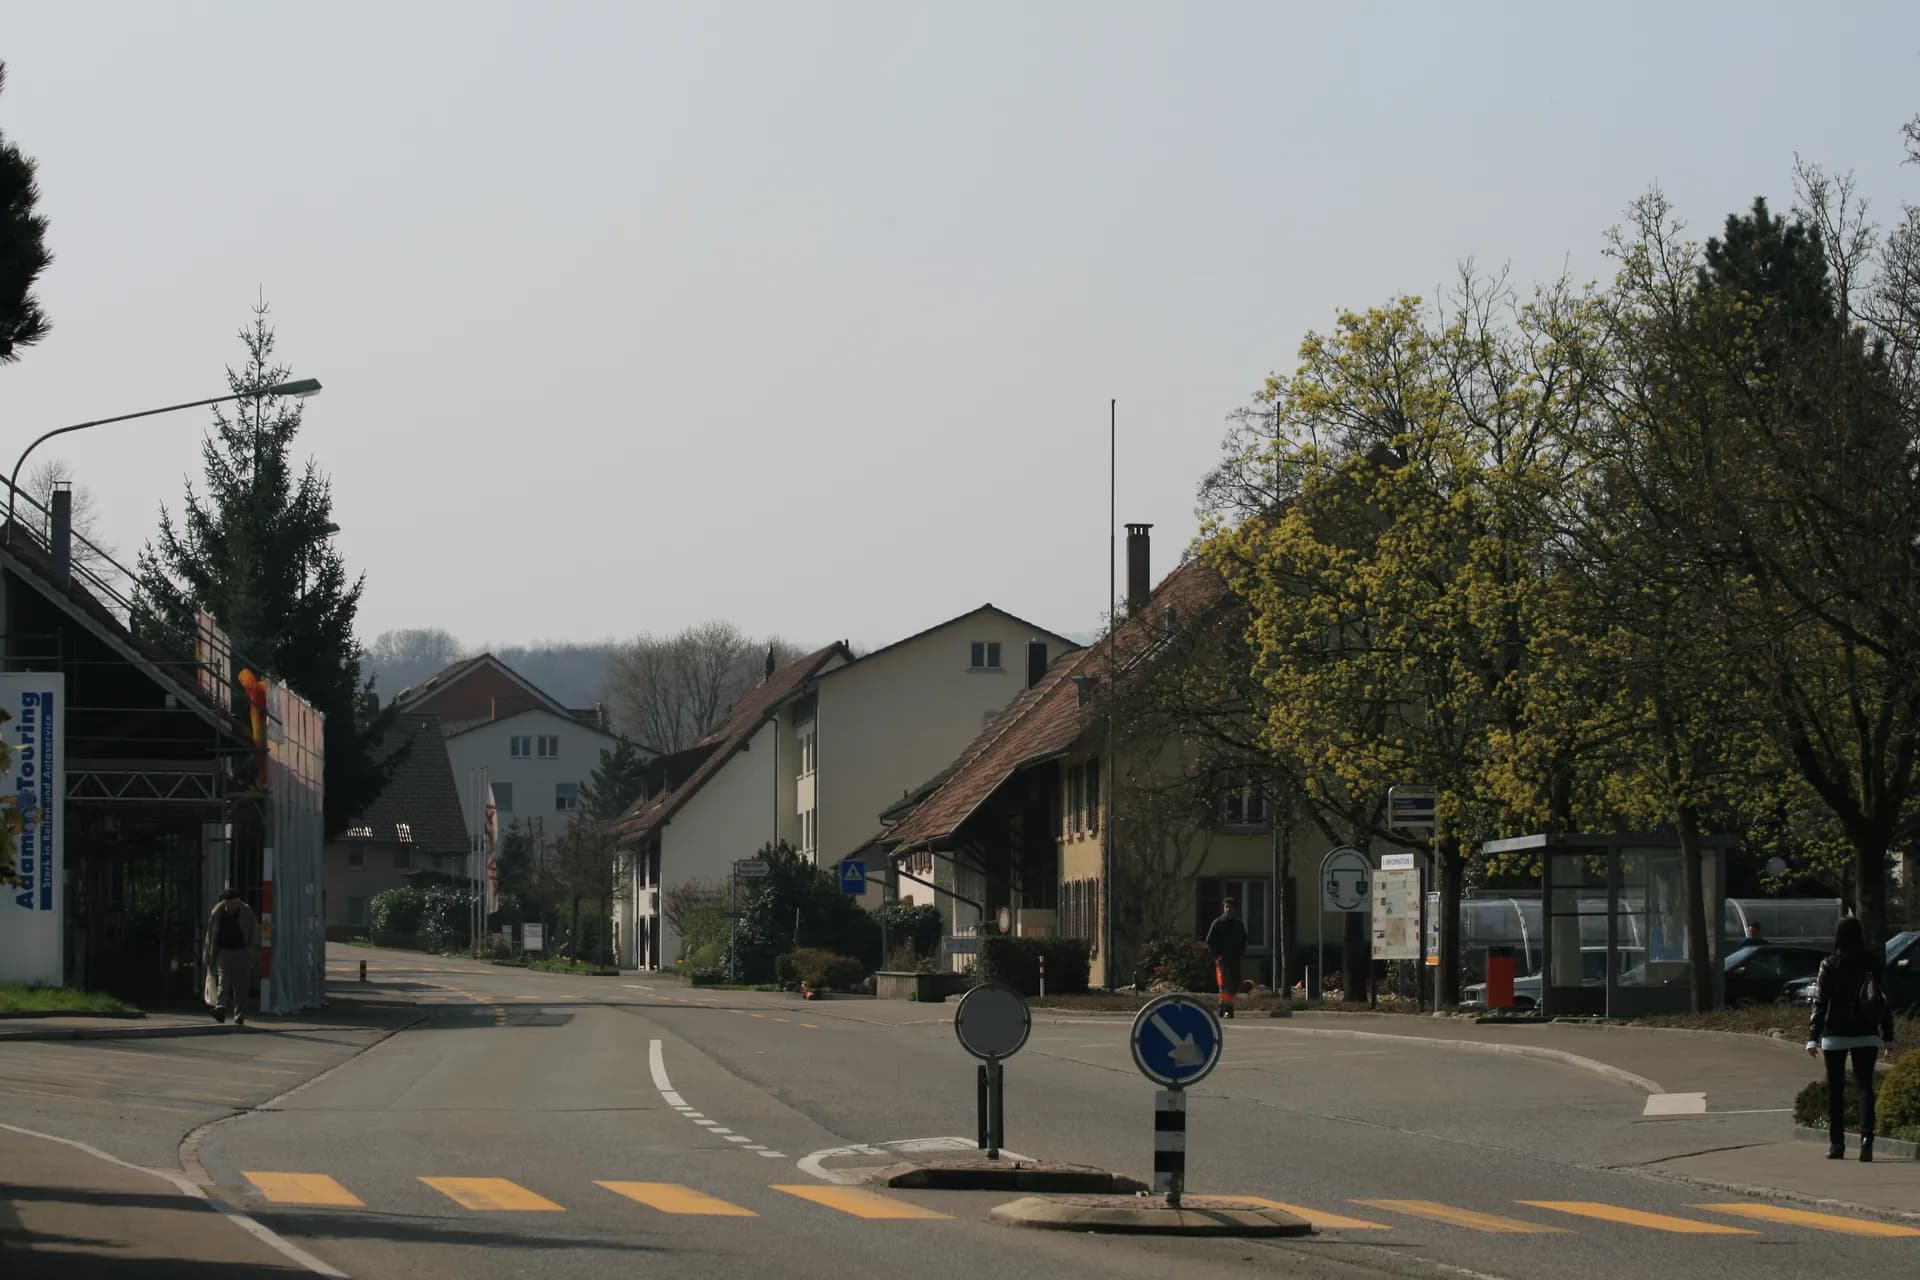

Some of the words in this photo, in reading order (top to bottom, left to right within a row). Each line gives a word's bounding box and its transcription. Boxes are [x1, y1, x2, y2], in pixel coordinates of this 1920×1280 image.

[16, 692, 40, 790] Touring
[42, 714, 52, 778] Autoservice
[42, 783, 52, 803] und
[42, 845, 51, 855] in
[42, 860, 51, 887] Stark
